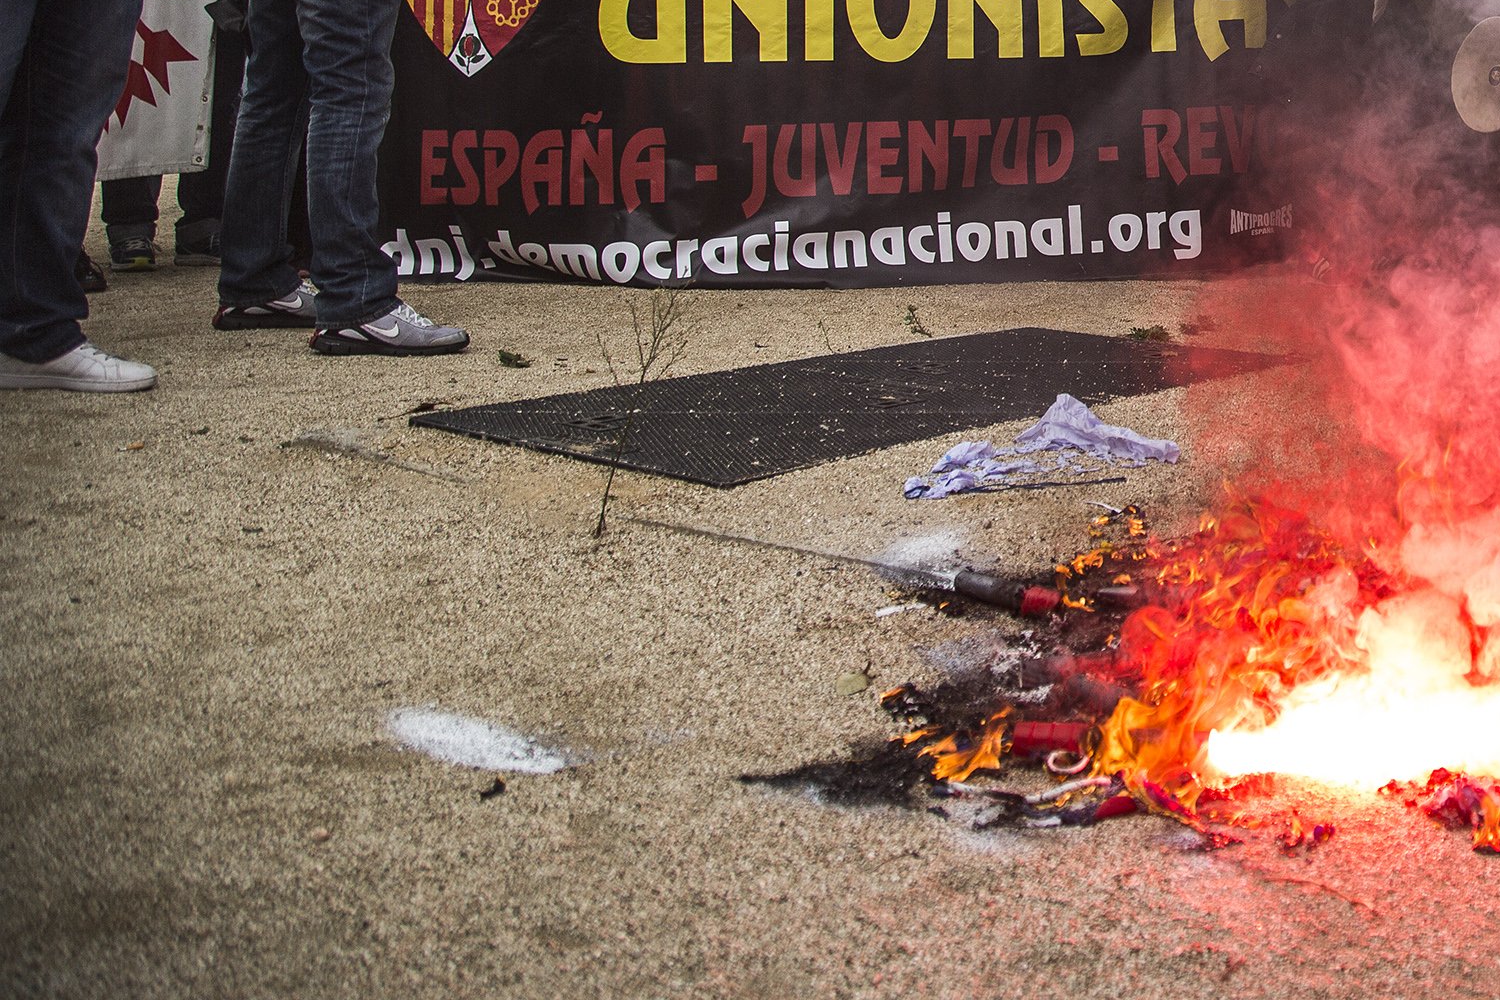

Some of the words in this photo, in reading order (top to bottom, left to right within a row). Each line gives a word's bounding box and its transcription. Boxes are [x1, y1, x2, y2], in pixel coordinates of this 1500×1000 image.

[420, 110, 667, 217] ESPAÑA
[695, 164, 718, 182] -
[741, 94, 1075, 220] JUVENTUD
[1098, 146, 1119, 162] -
[380, 203, 1202, 284] dnj.democracianacional.org
[1230, 203, 1293, 235] ANTIPROGRES
